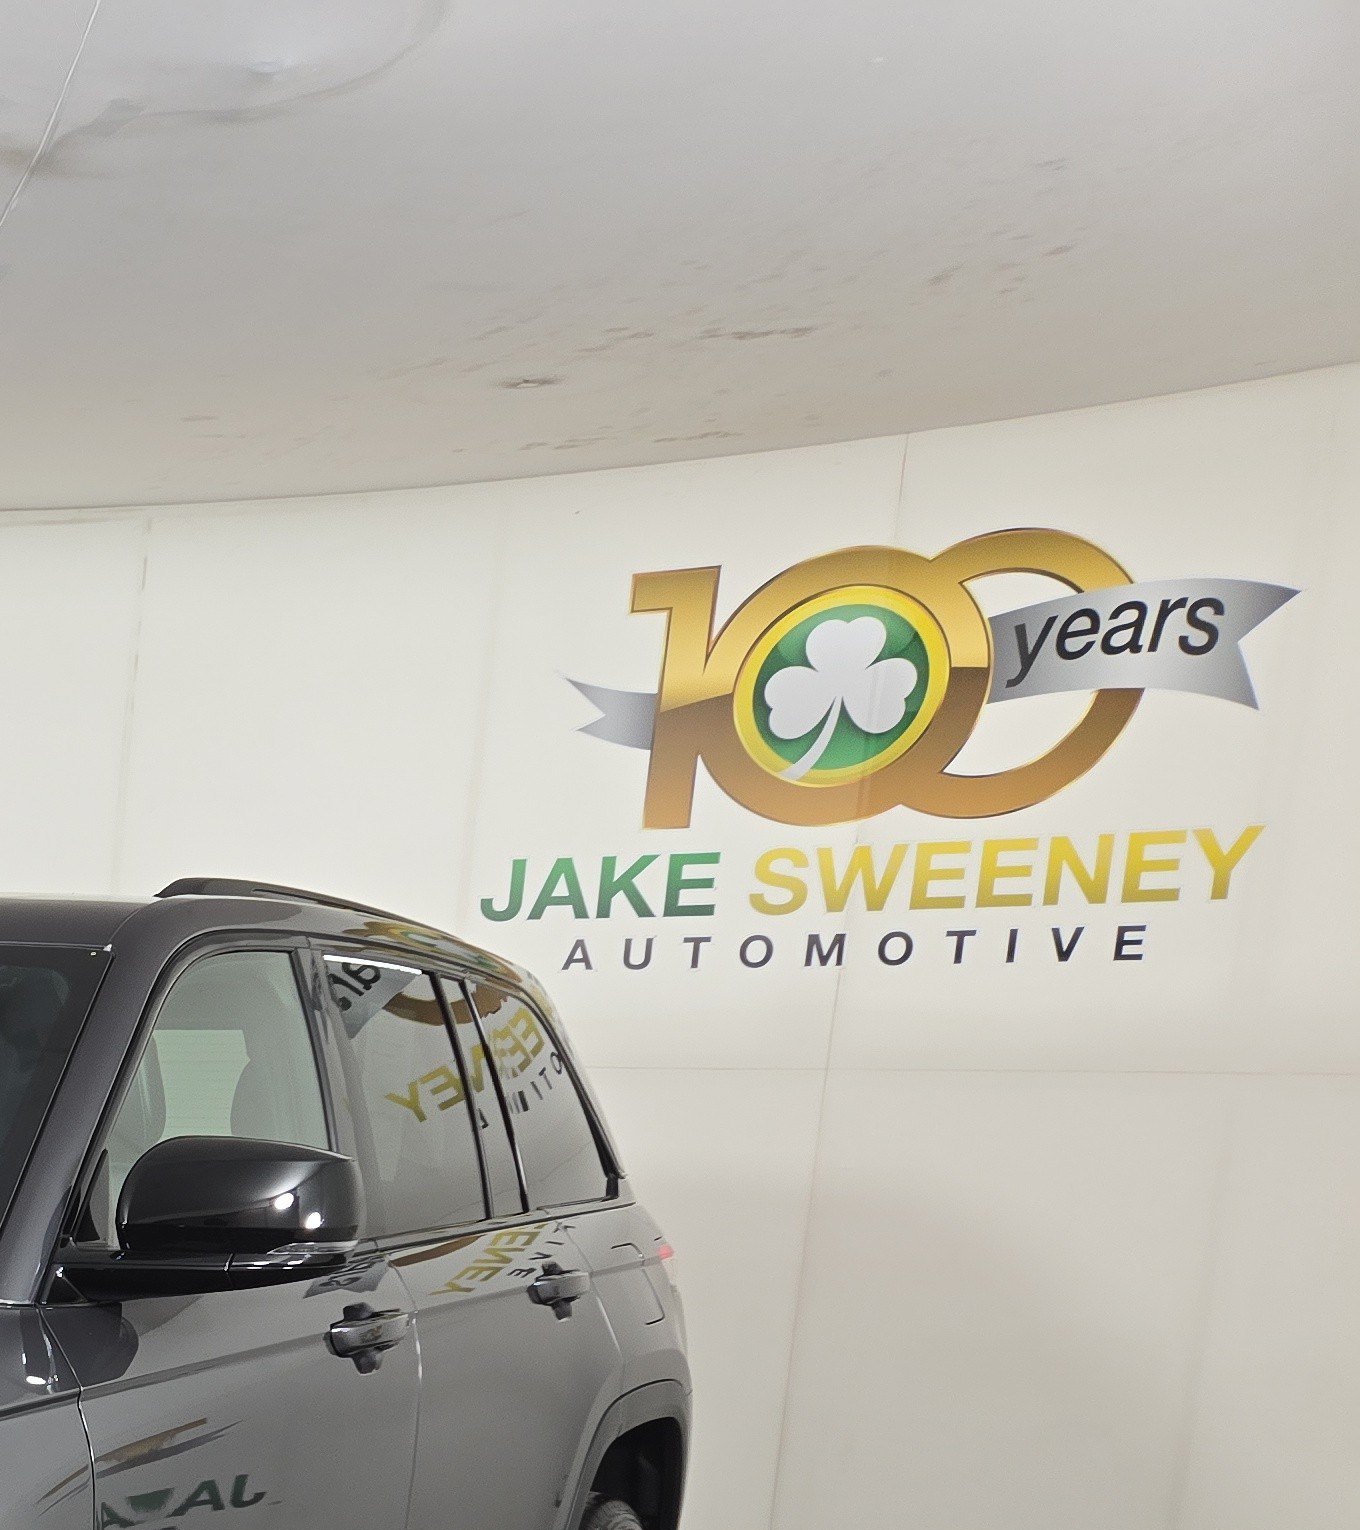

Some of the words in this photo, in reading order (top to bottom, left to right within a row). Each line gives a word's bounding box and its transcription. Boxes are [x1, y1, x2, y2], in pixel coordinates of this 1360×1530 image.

[1005, 595, 1225, 689] years
[479, 851, 721, 922] JAKE
[748, 825, 1265, 916] SWEENEY
[562, 924, 1147, 972] AUTOMOTIVE
